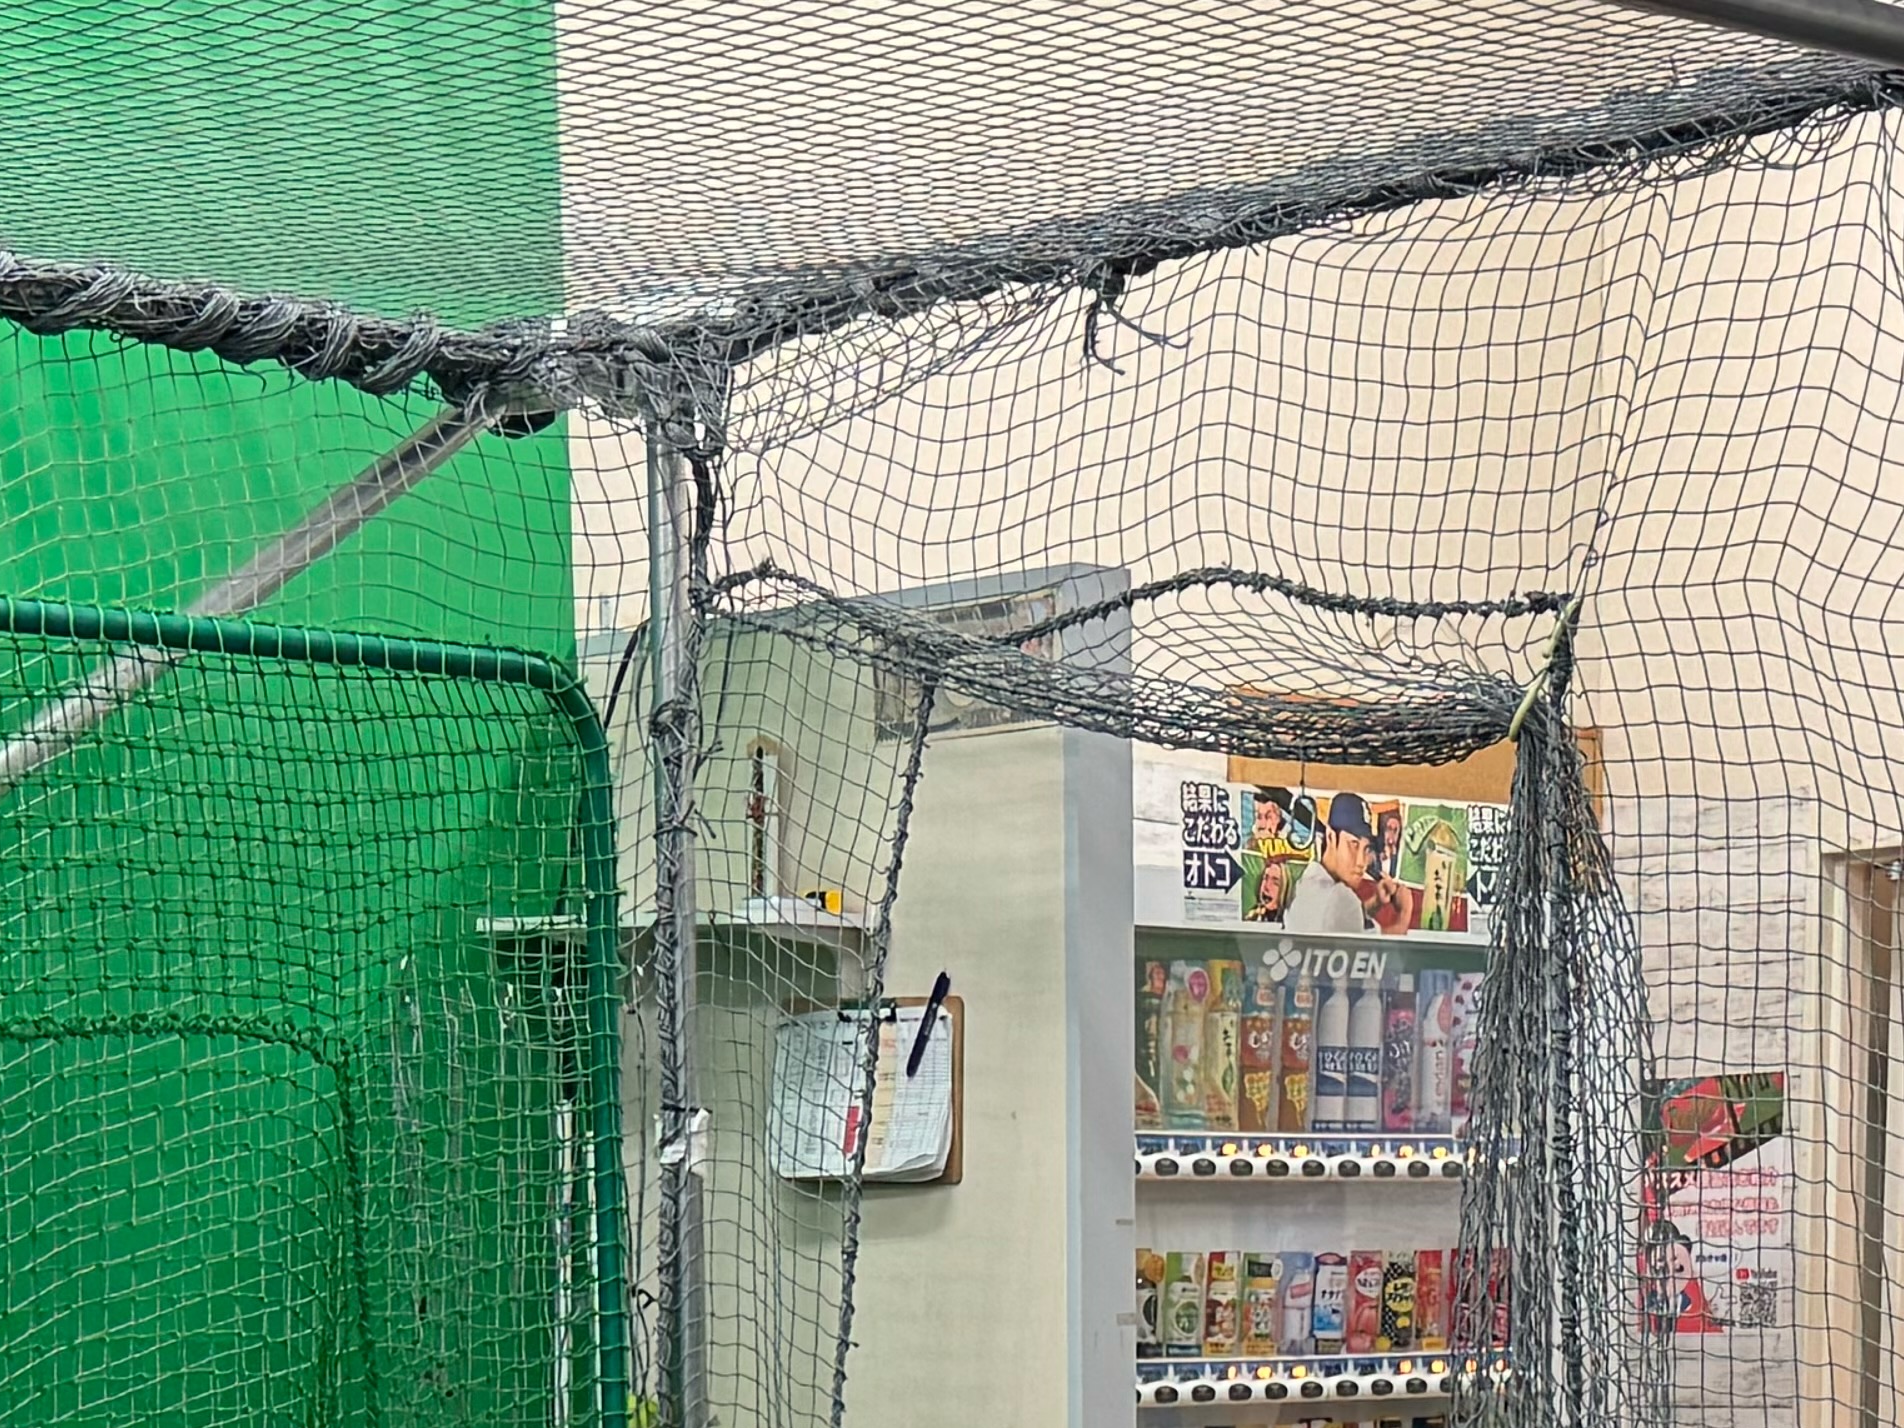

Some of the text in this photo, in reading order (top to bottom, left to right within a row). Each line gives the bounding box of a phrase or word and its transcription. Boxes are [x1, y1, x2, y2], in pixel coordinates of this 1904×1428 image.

[1181, 781, 1230, 813] 結果に
[1182, 815, 1240, 849] こだわる
[1184, 857, 1232, 893] オトコ
